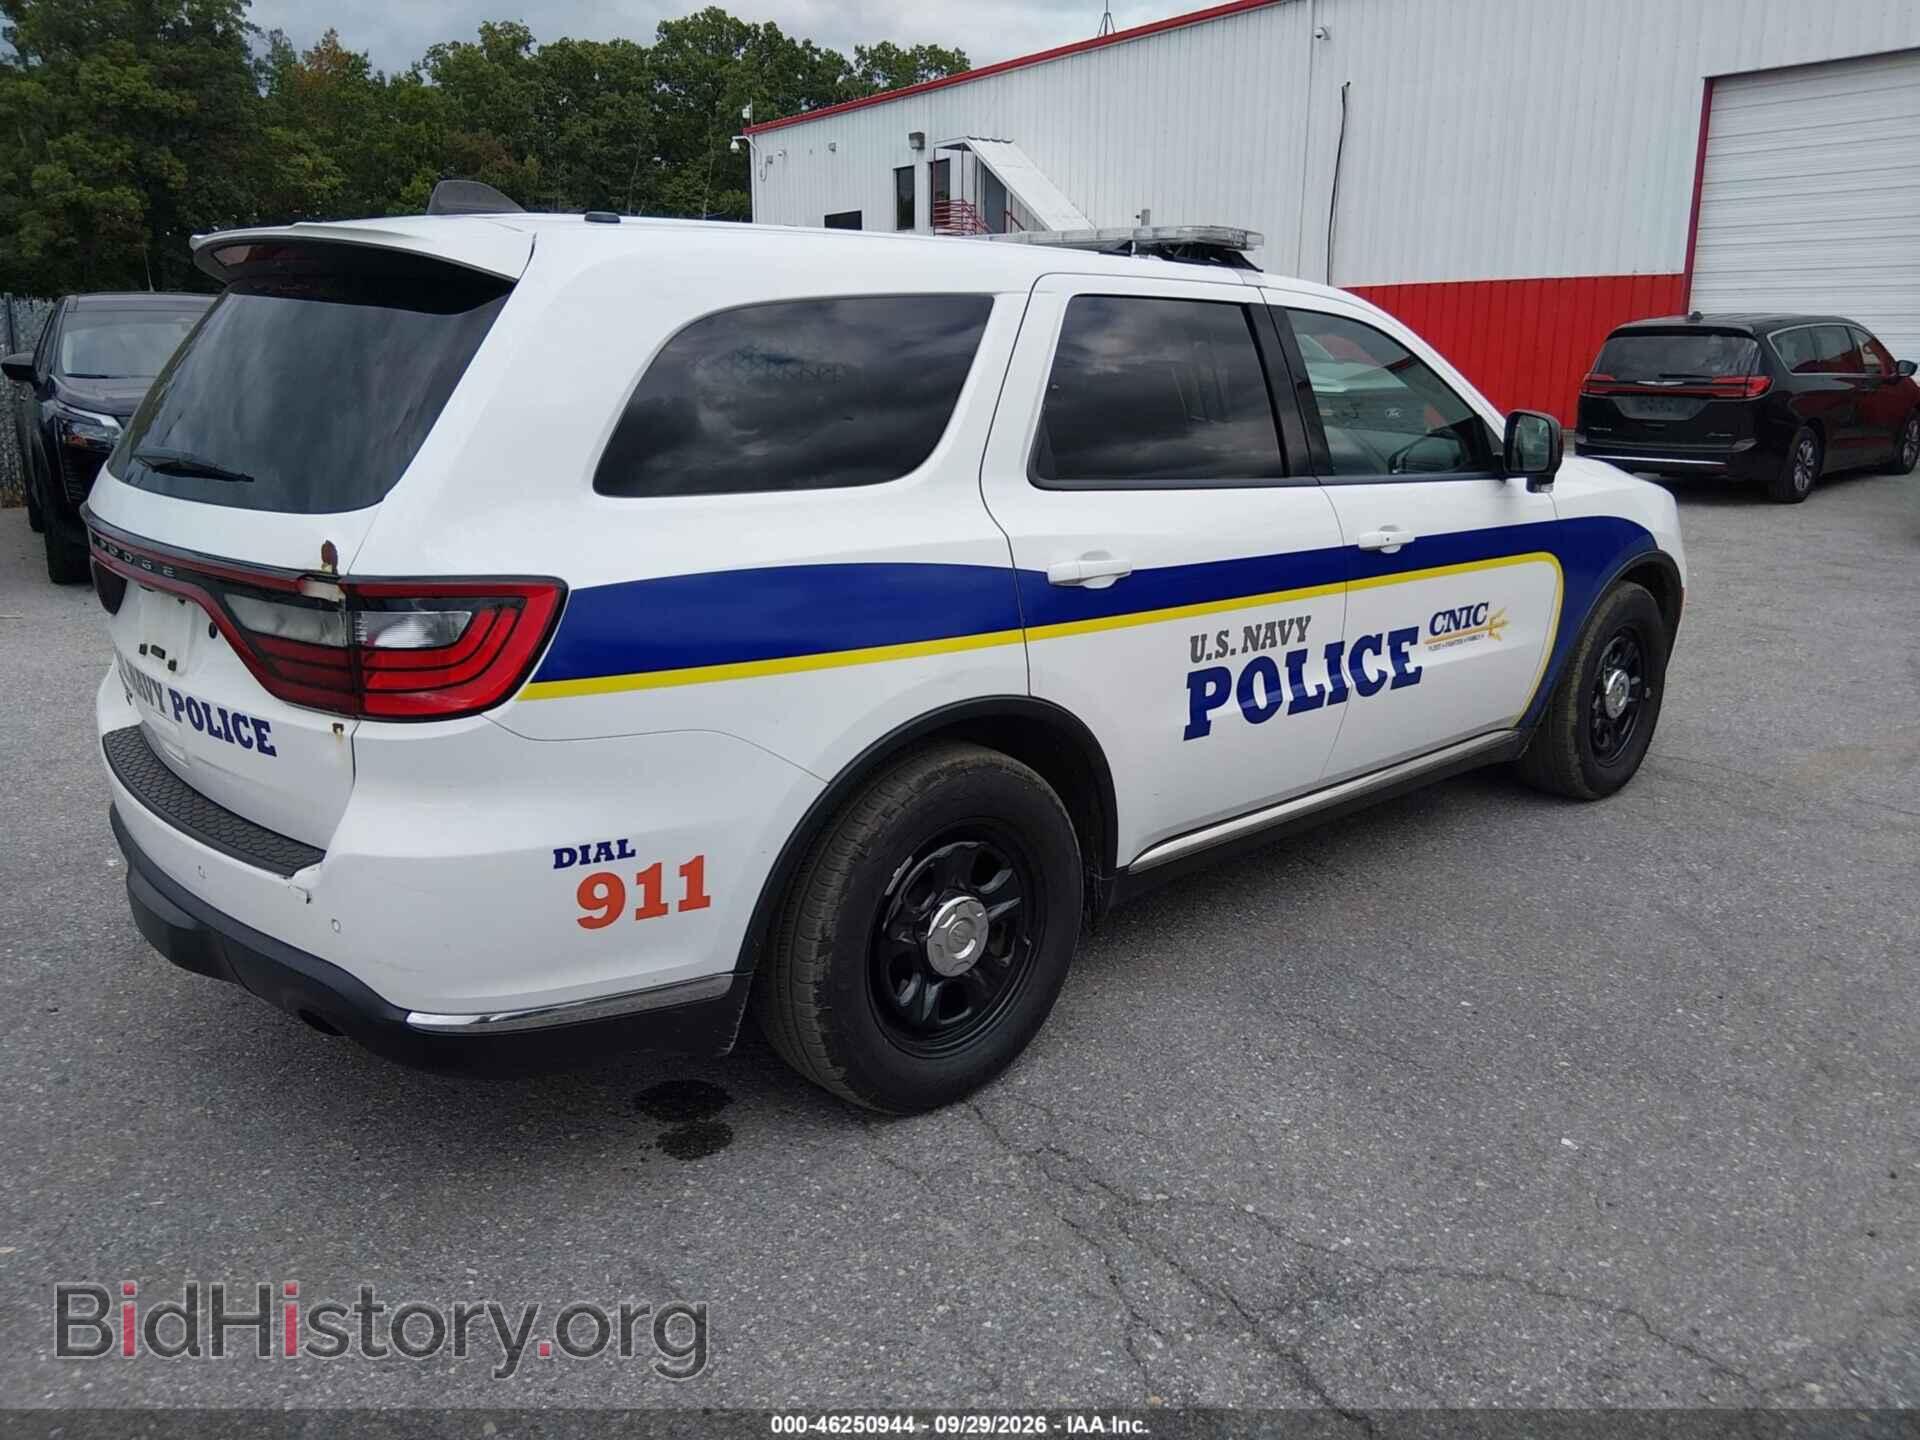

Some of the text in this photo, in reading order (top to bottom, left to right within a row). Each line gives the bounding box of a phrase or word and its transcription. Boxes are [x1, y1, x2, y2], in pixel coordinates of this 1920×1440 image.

[1190, 615, 1312, 663] U.S. NAVY
[1429, 601, 1489, 636] CNIC
[1183, 626, 1424, 741] POLICE
[167, 687, 278, 758] POLICE
[553, 838, 637, 870] DIAL
[576, 854, 711, 930] 911
